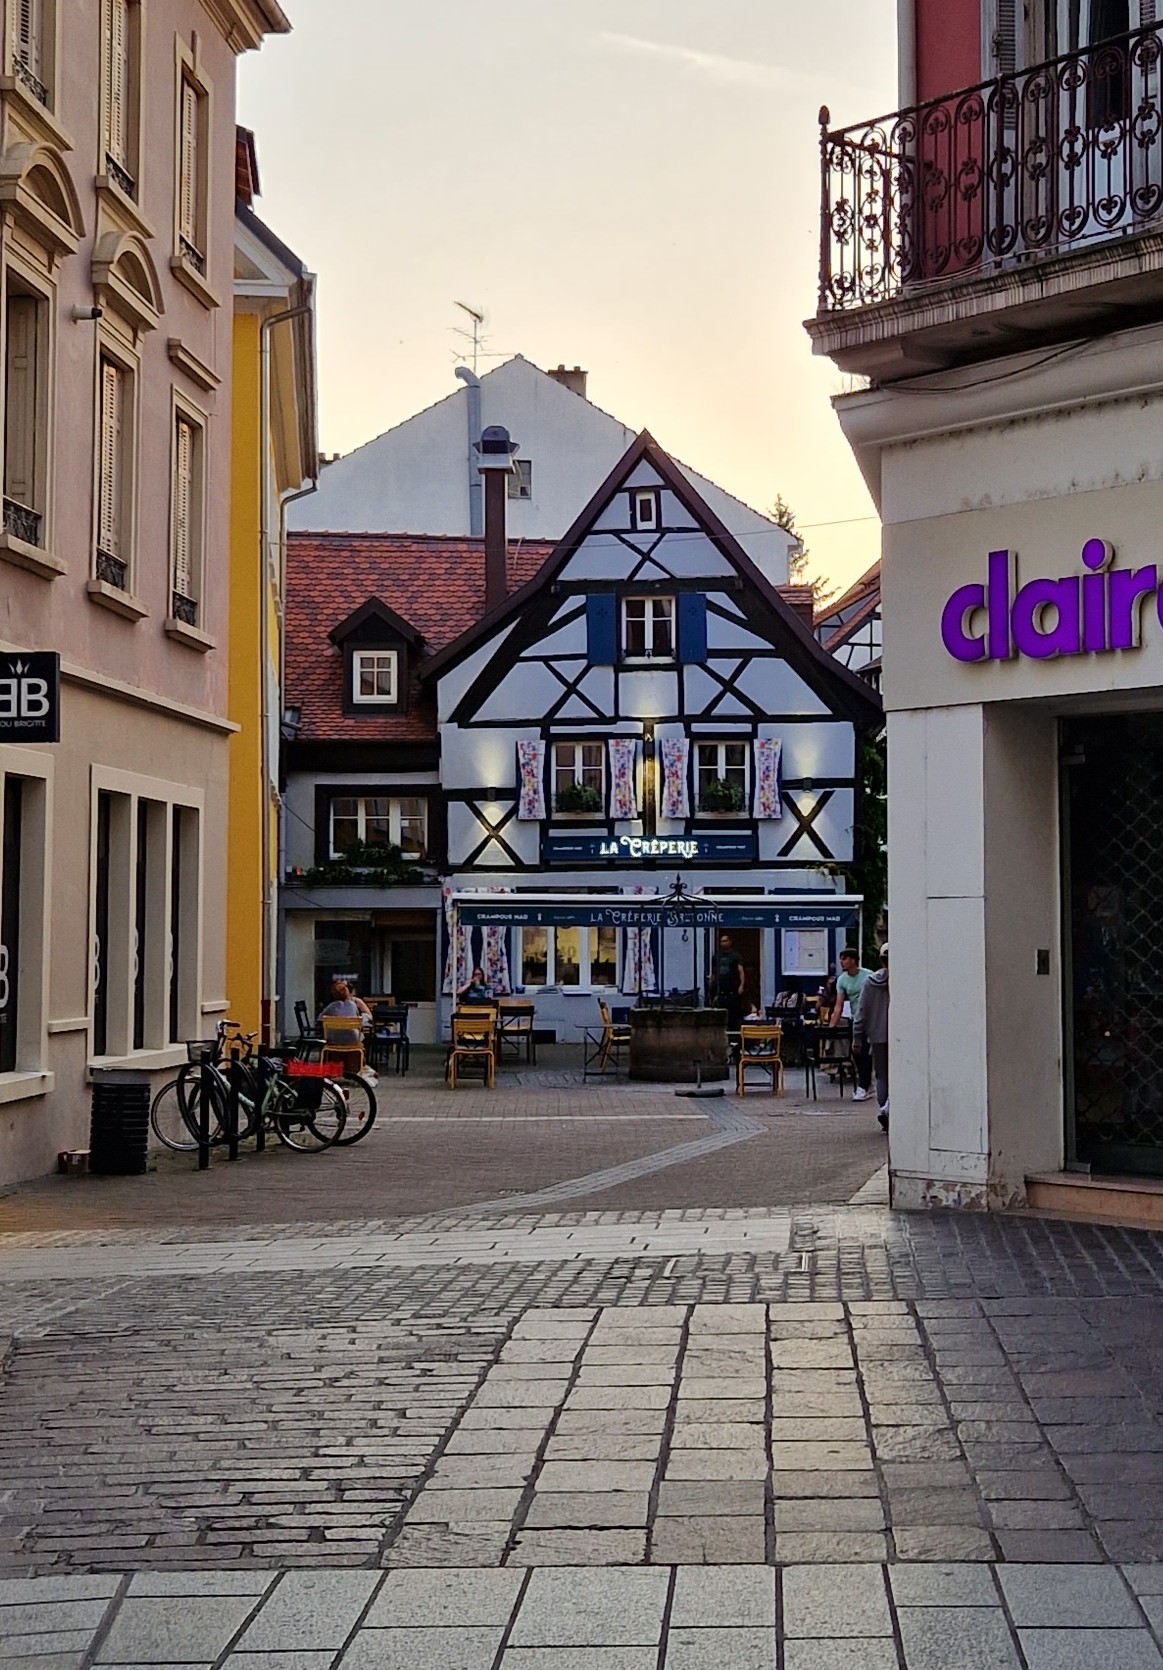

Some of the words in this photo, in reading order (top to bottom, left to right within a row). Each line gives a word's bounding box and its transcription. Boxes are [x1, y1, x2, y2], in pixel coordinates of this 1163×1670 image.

[941, 538, 1163, 662] clair
[599, 841, 619, 855] LA
[590, 912, 604, 922] LA
